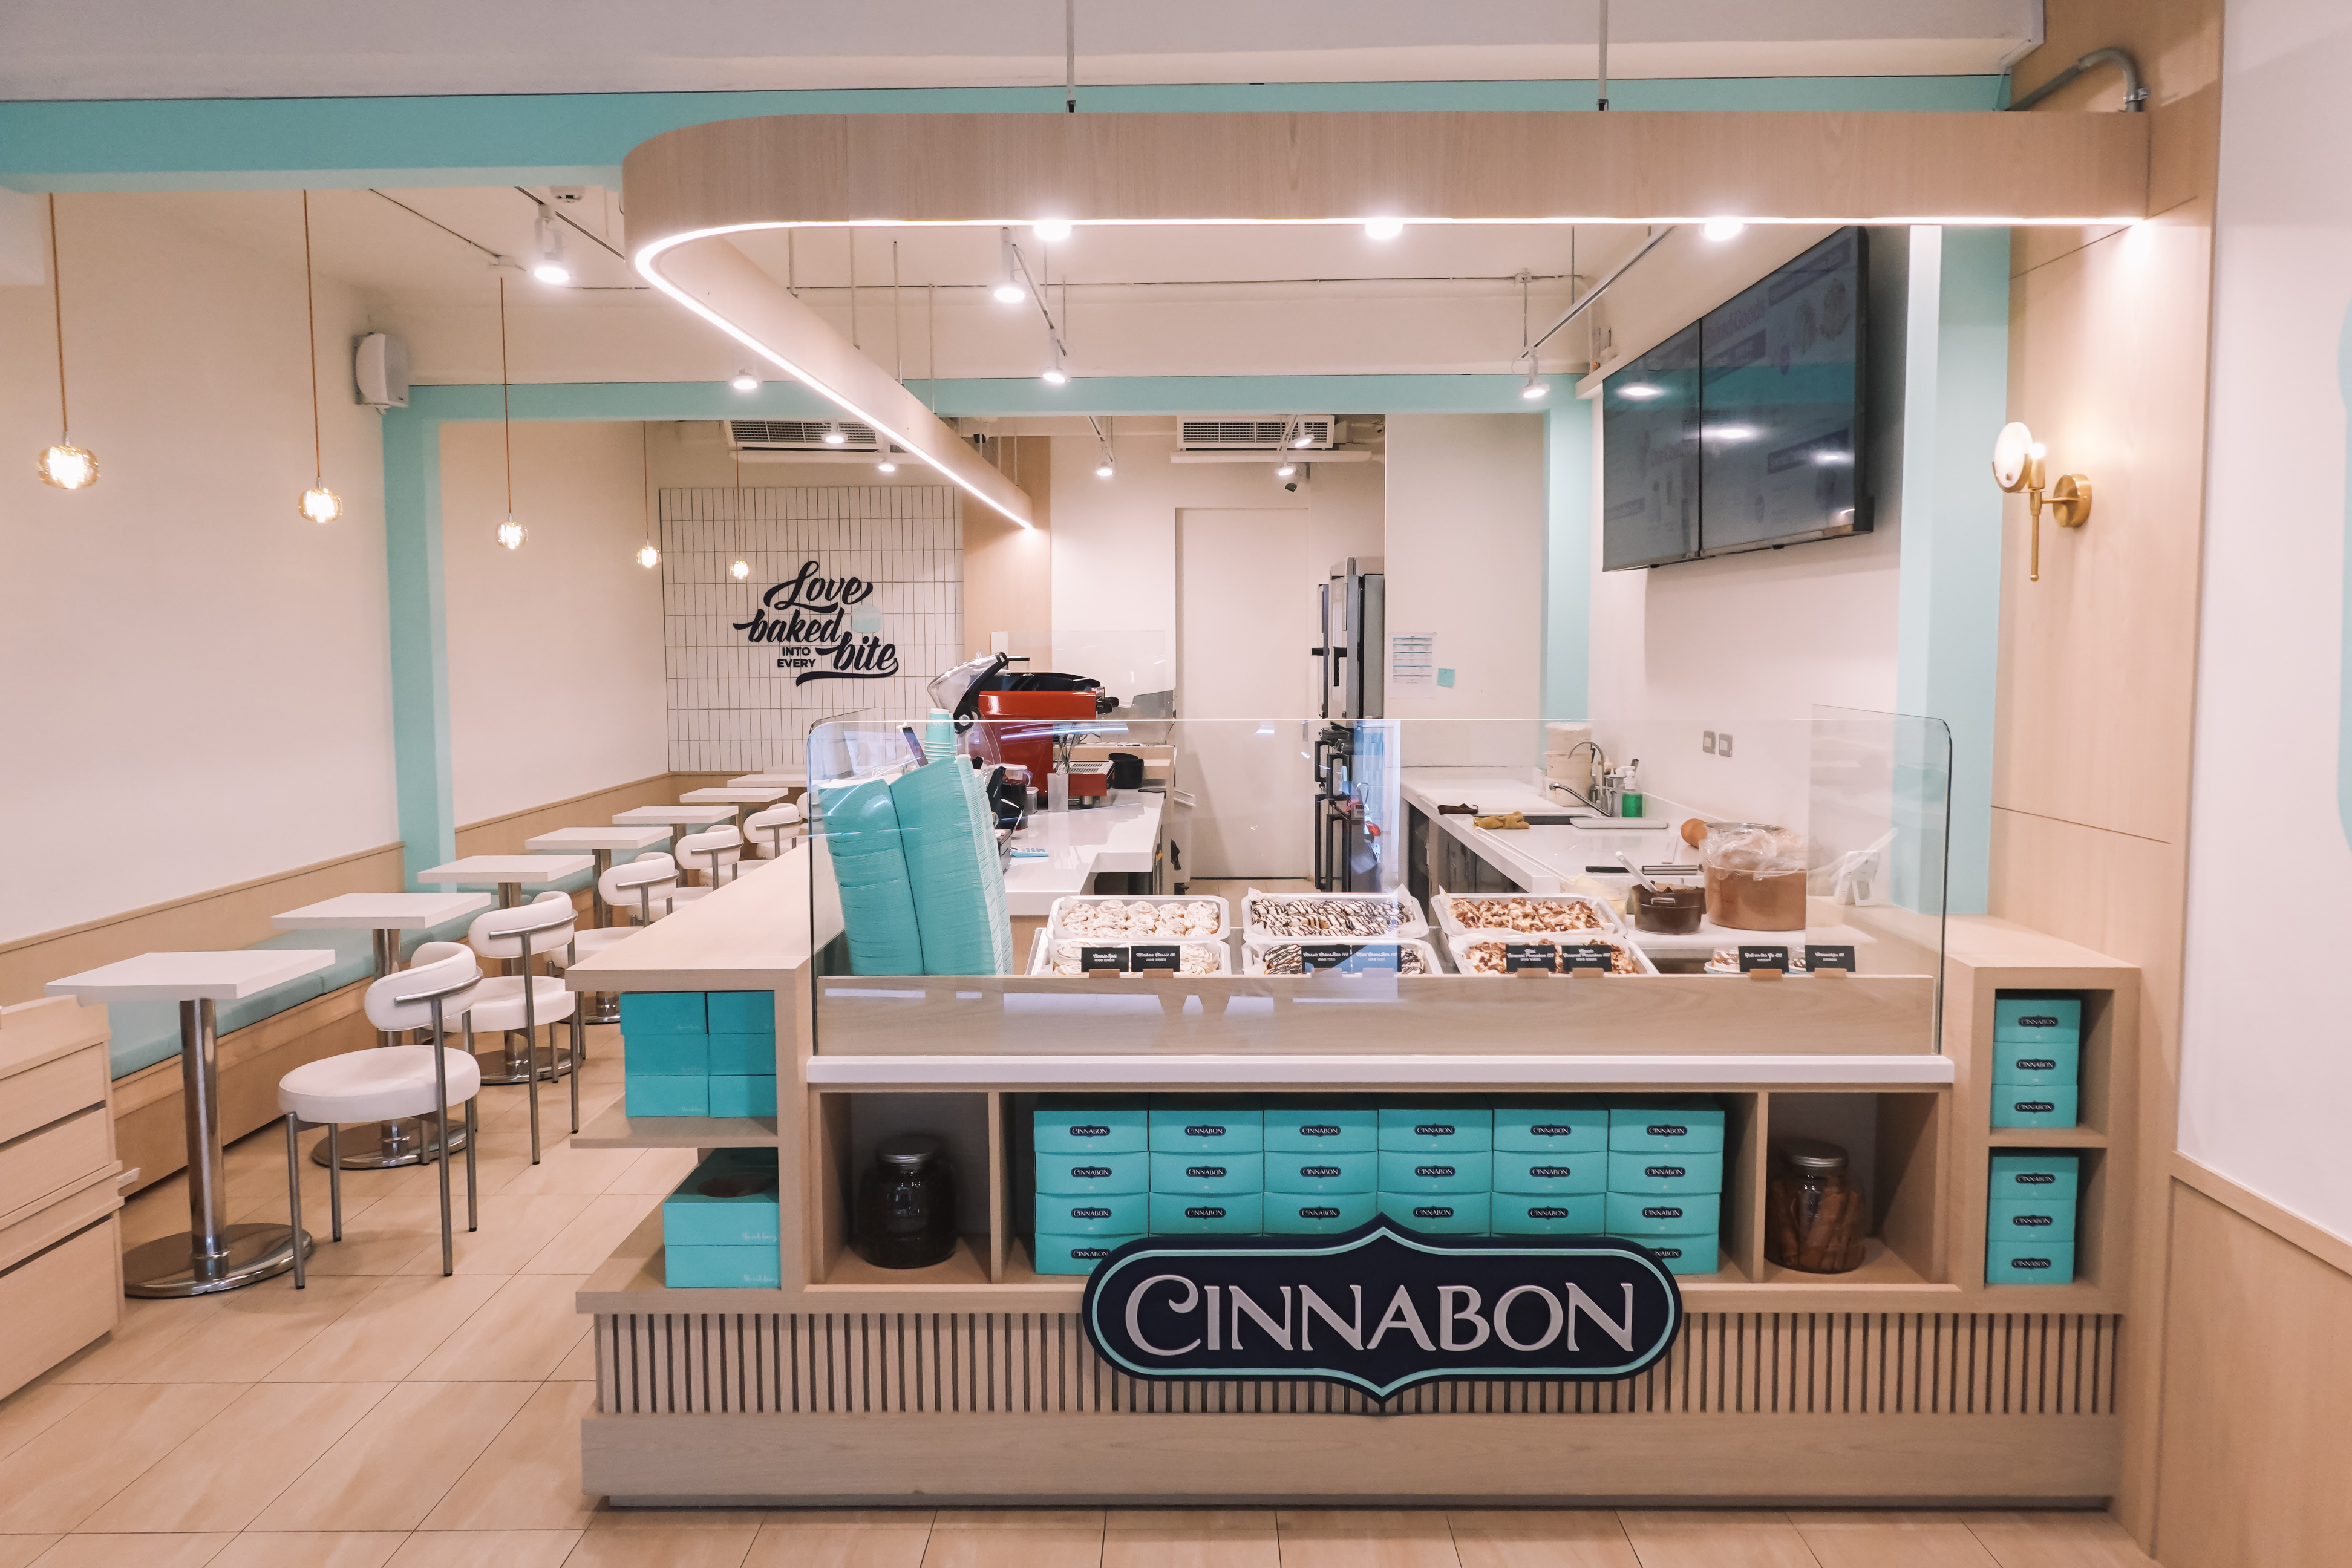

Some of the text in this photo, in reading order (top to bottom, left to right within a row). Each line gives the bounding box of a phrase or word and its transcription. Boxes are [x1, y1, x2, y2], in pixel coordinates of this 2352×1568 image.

[763, 560, 874, 614] Love
[733, 606, 845, 643] baked
[777, 658, 816, 668] EVERY
[782, 647, 811, 656] INTO
[795, 631, 899, 687] bite
[1124, 1274, 1633, 1356] CINNABON
